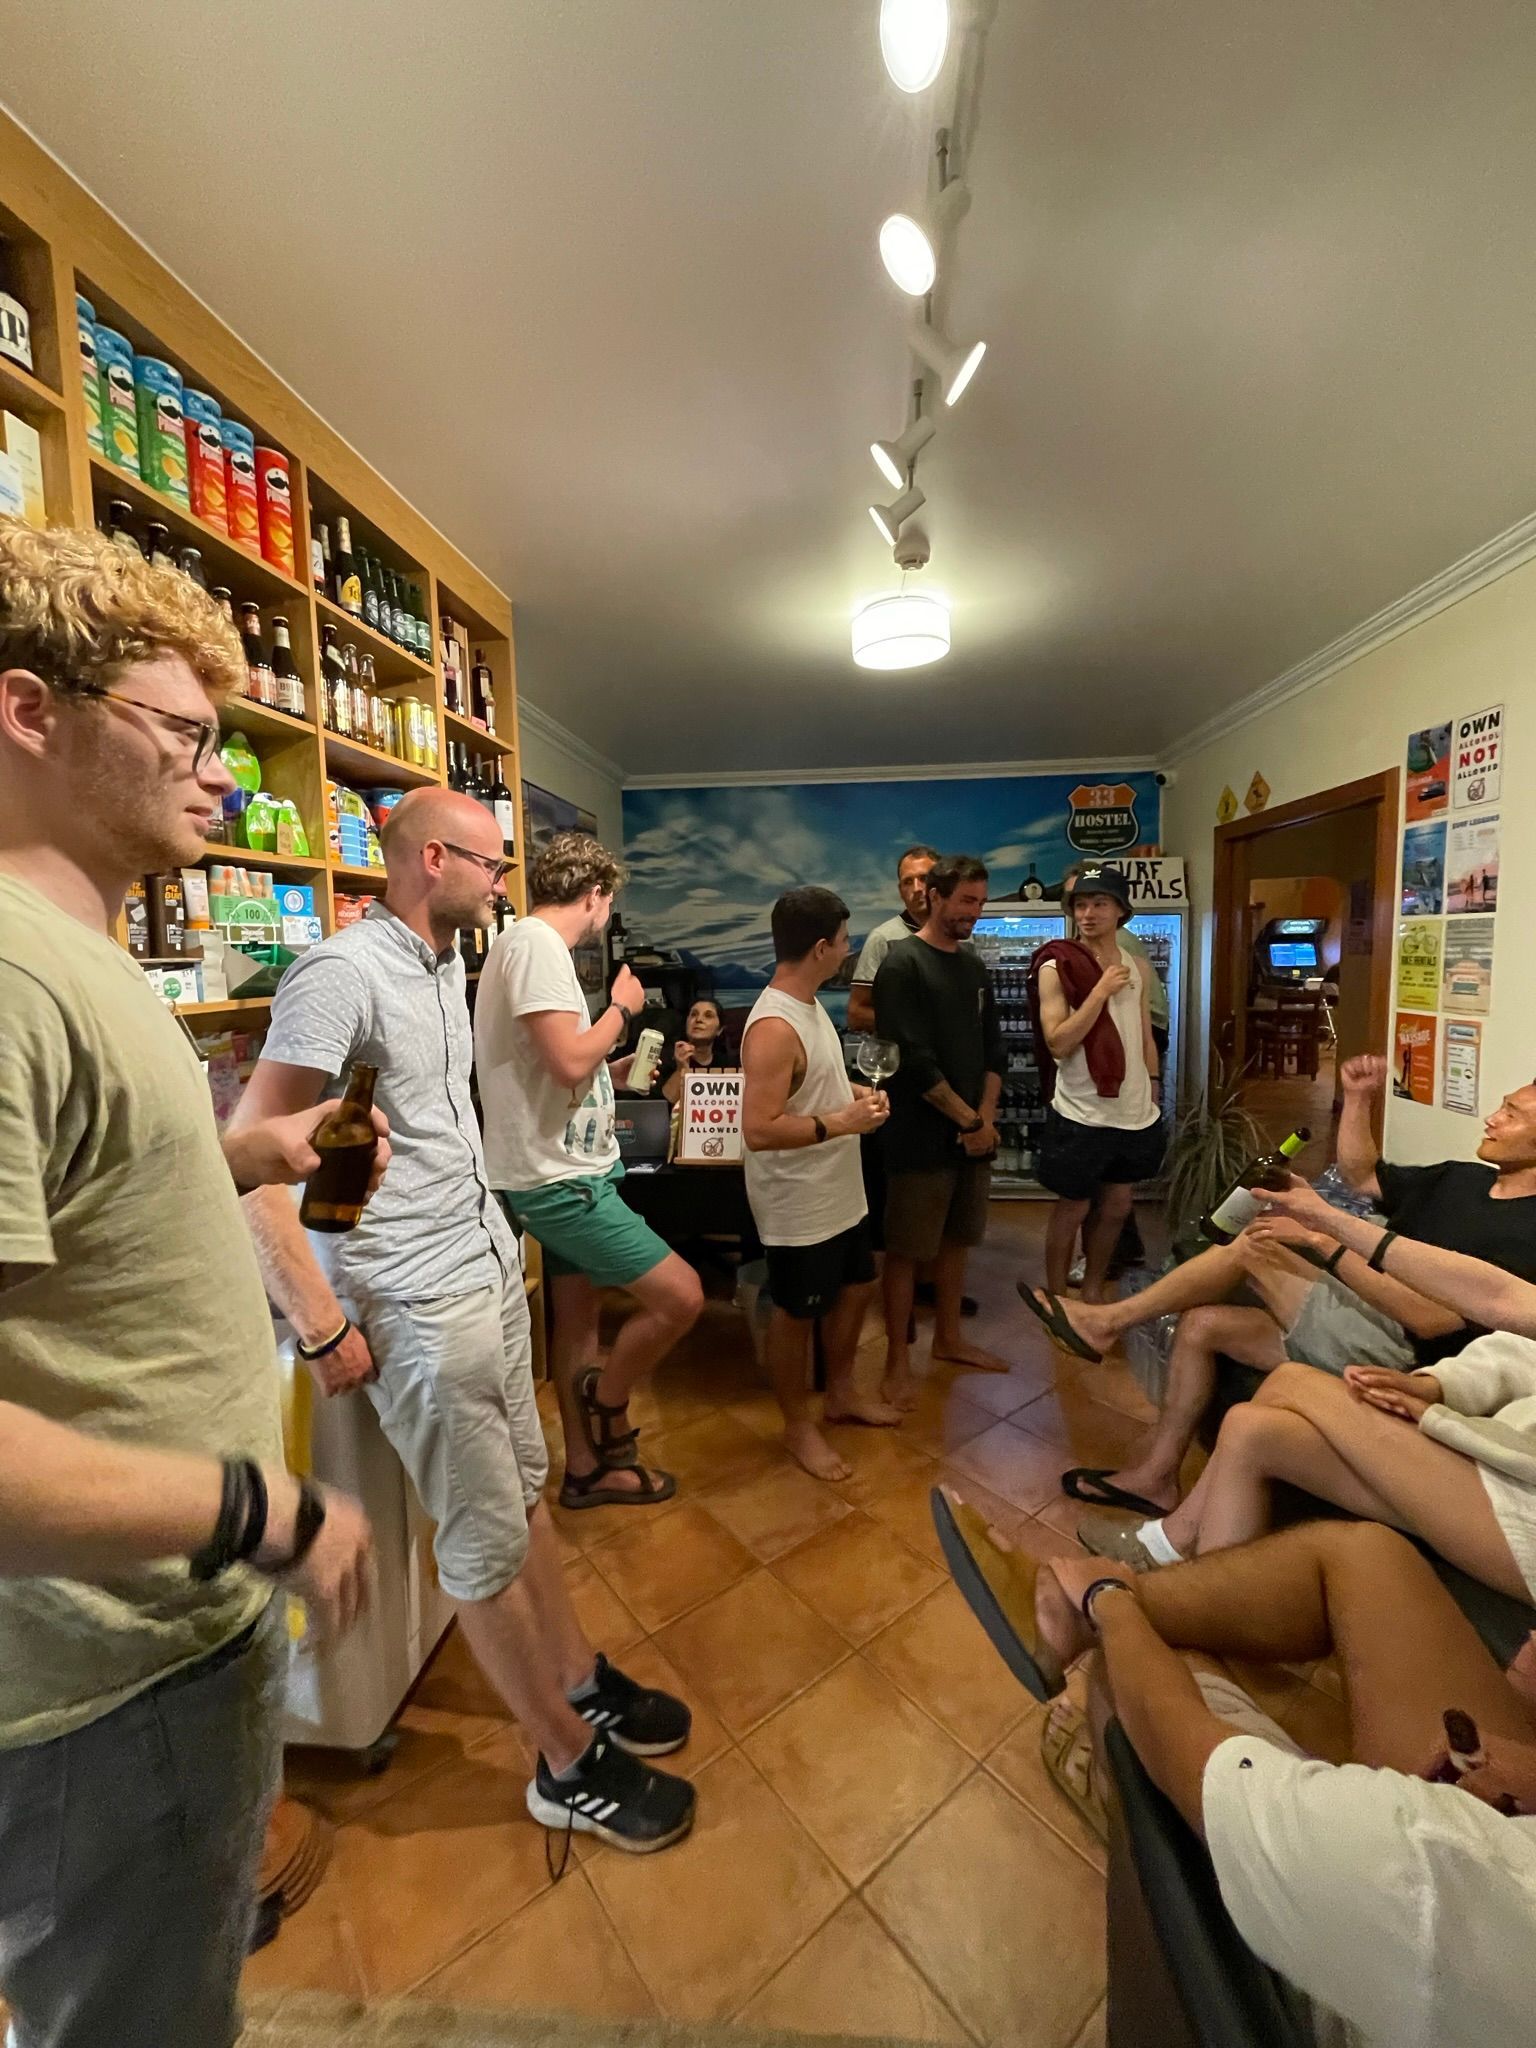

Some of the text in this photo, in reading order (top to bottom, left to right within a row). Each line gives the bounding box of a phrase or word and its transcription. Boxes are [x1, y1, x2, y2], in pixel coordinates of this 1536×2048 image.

[1460, 711, 1500, 738] OWN
[1458, 732, 1499, 750] ALCOHOL
[1459, 744, 1498, 768] NOT
[1457, 763, 1498, 780] ALLOWED
[1089, 789, 1115, 806] 33
[1075, 813, 1131, 827] HOSTEL
[1127, 878, 1183, 899] TALS
[245, 909, 260, 920] 100
[691, 1082, 739, 1096] OWN
[692, 1109, 737, 1124] NOT
[689, 1126, 739, 1134] ALLOWED
